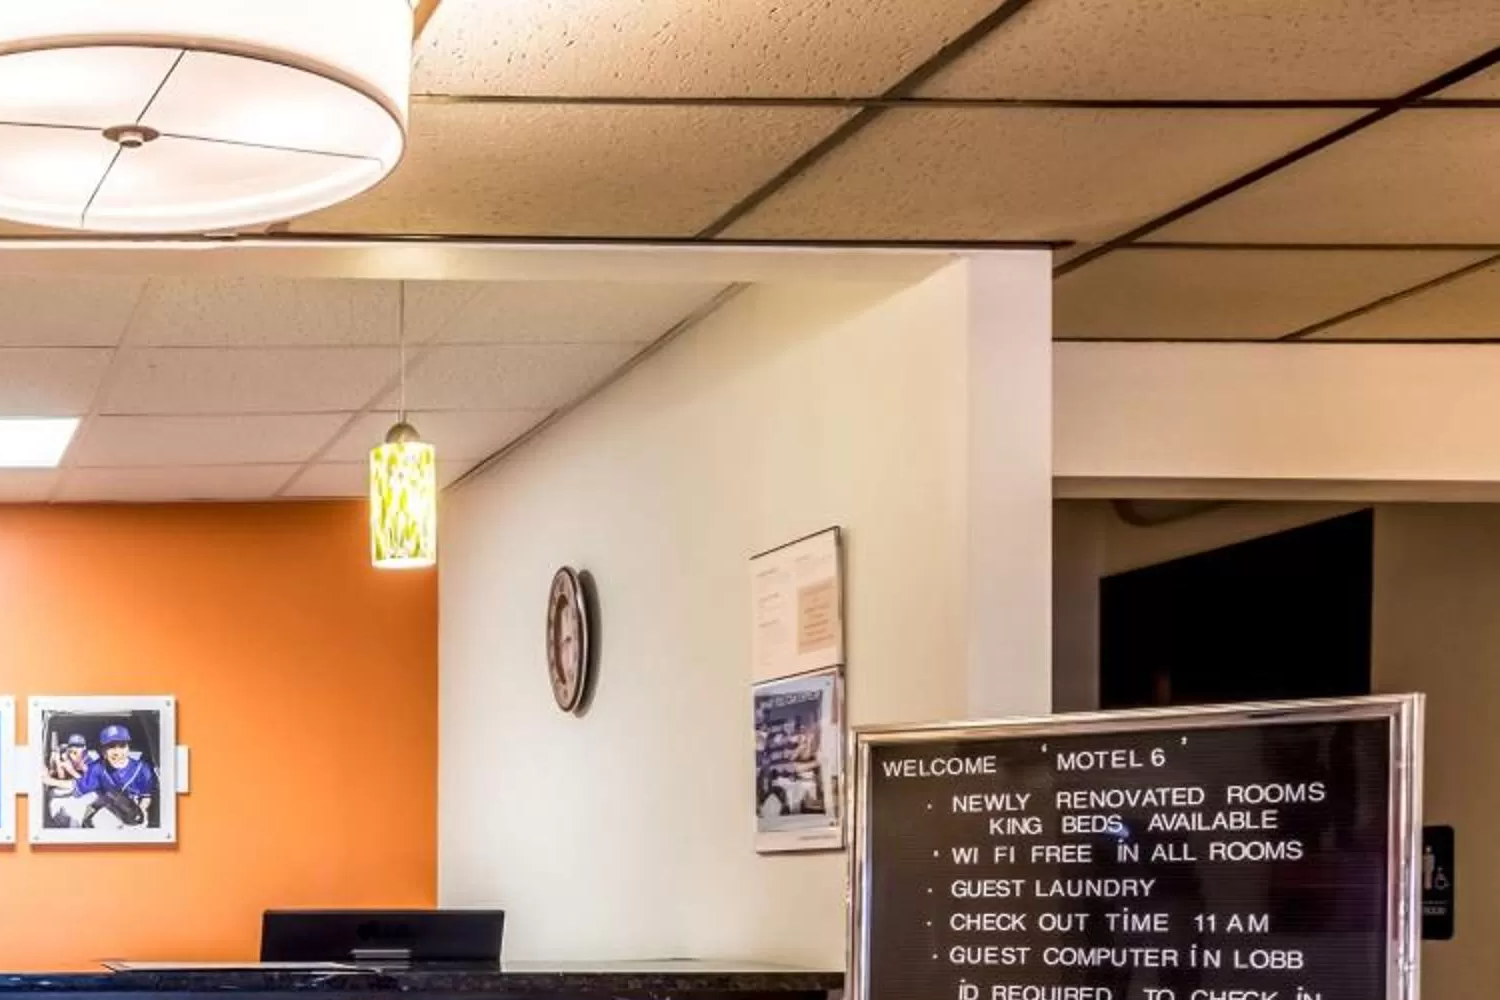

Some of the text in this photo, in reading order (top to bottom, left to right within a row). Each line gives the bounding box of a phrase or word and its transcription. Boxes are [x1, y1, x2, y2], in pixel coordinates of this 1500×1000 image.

[883, 748, 1166, 777] WELCOME MOTEL 6
[952, 782, 1326, 812] NEWLY RENOVATED ROOMS
[989, 810, 1279, 835] KING BEDS AVAILABLE
[952, 848, 978, 864] WI
[995, 847, 1015, 864] FI
[1031, 845, 1092, 863] FREE
[1151, 844, 1197, 861] ALL
[1209, 841, 1303, 861] ROOMS
[951, 878, 1156, 898] GUEST LAUNDRY
[950, 913, 1027, 931] CHECK
[1038, 913, 1089, 931] OUT
[1194, 914, 1216, 932] 11
[950, 946, 1031, 965] GUEST
[1043, 947, 1179, 967] COMPUTER
[1234, 950, 1304, 969] LOBB
